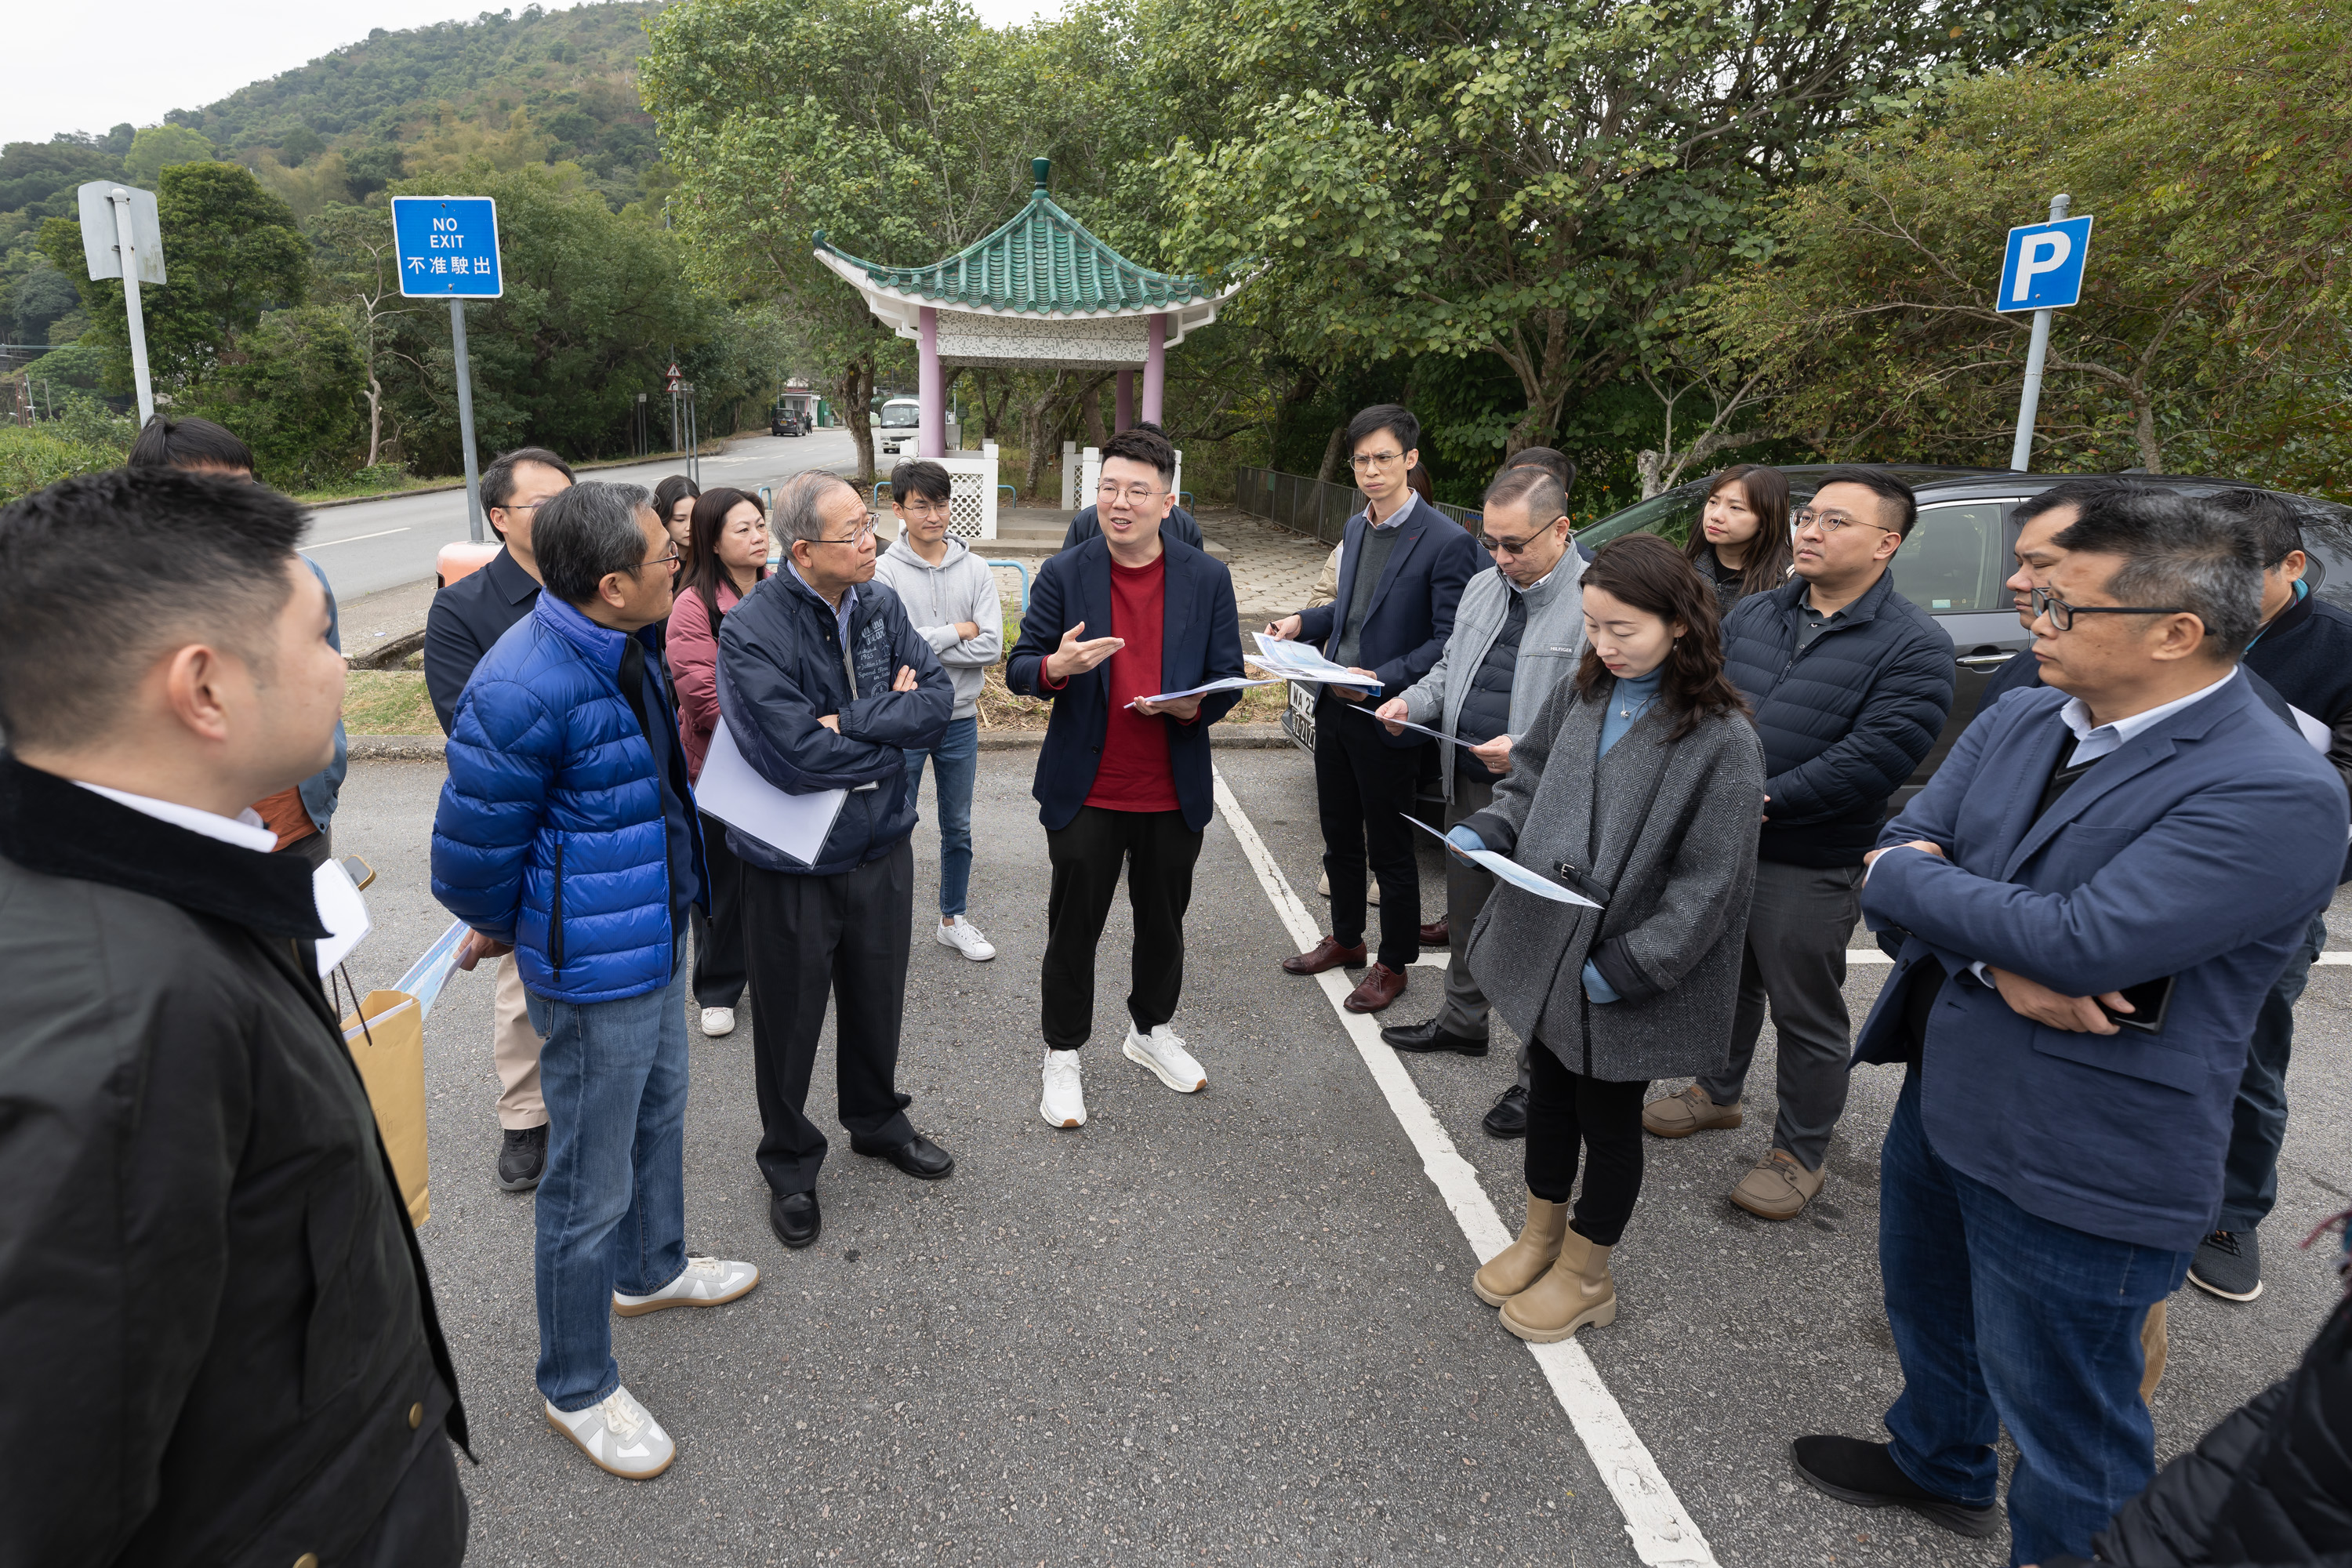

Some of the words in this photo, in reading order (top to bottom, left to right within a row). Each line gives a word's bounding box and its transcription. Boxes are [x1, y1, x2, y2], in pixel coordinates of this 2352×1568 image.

[433, 217, 458, 231] NO
[430, 234, 465, 249] EXIT
[407, 256, 491, 275] 不准駛出
[2012, 230, 2071, 302] P
[858, 668, 877, 679] Spend
[1293, 686, 1303, 710] WA
